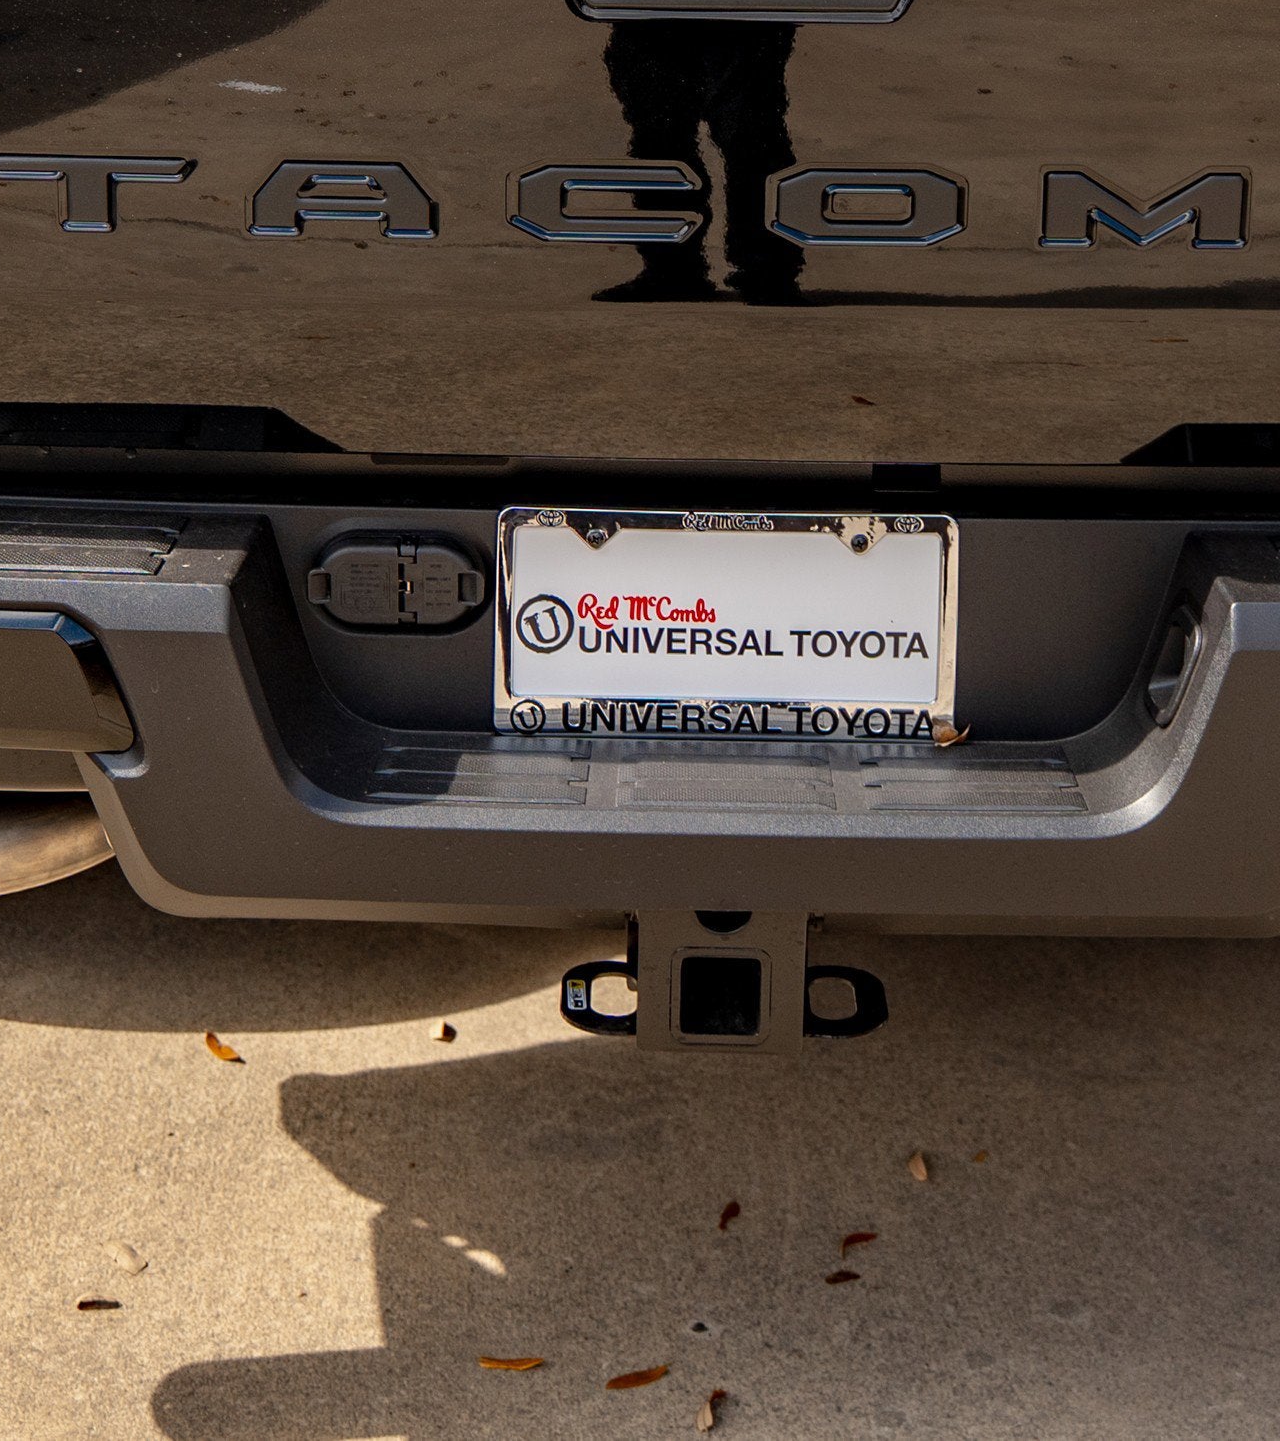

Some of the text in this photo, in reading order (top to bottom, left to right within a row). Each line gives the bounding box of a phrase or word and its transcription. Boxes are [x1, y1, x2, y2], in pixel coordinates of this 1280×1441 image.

[577, 593, 717, 630] Red McCombs
[578, 625, 930, 659] UNIVERSAL TOYOTA
[561, 700, 934, 739] UNIVERSAL TOYOTA
